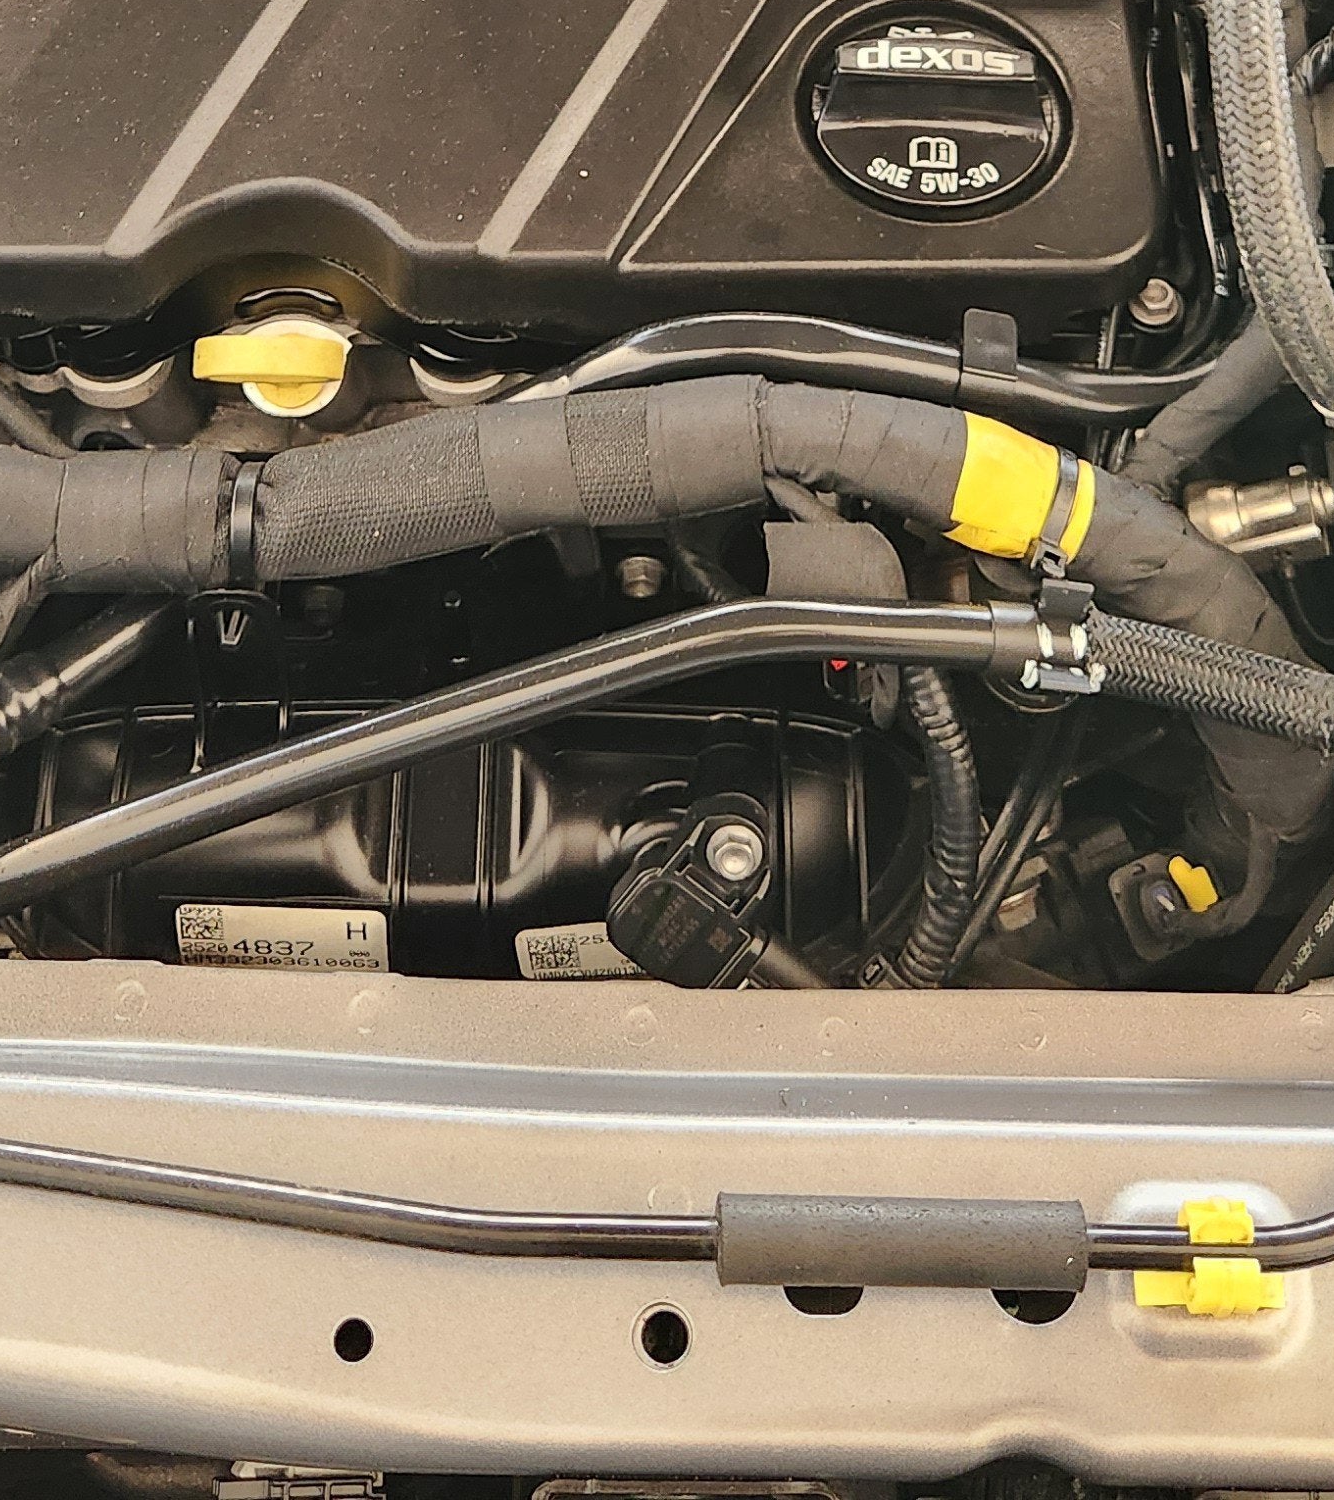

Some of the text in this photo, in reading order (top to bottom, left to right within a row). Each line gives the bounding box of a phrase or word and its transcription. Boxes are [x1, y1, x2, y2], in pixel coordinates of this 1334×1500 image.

[857, 39, 1021, 76] dexos
[866, 157, 1000, 195] SAE 5W-30
[345, 921, 368, 941] H
